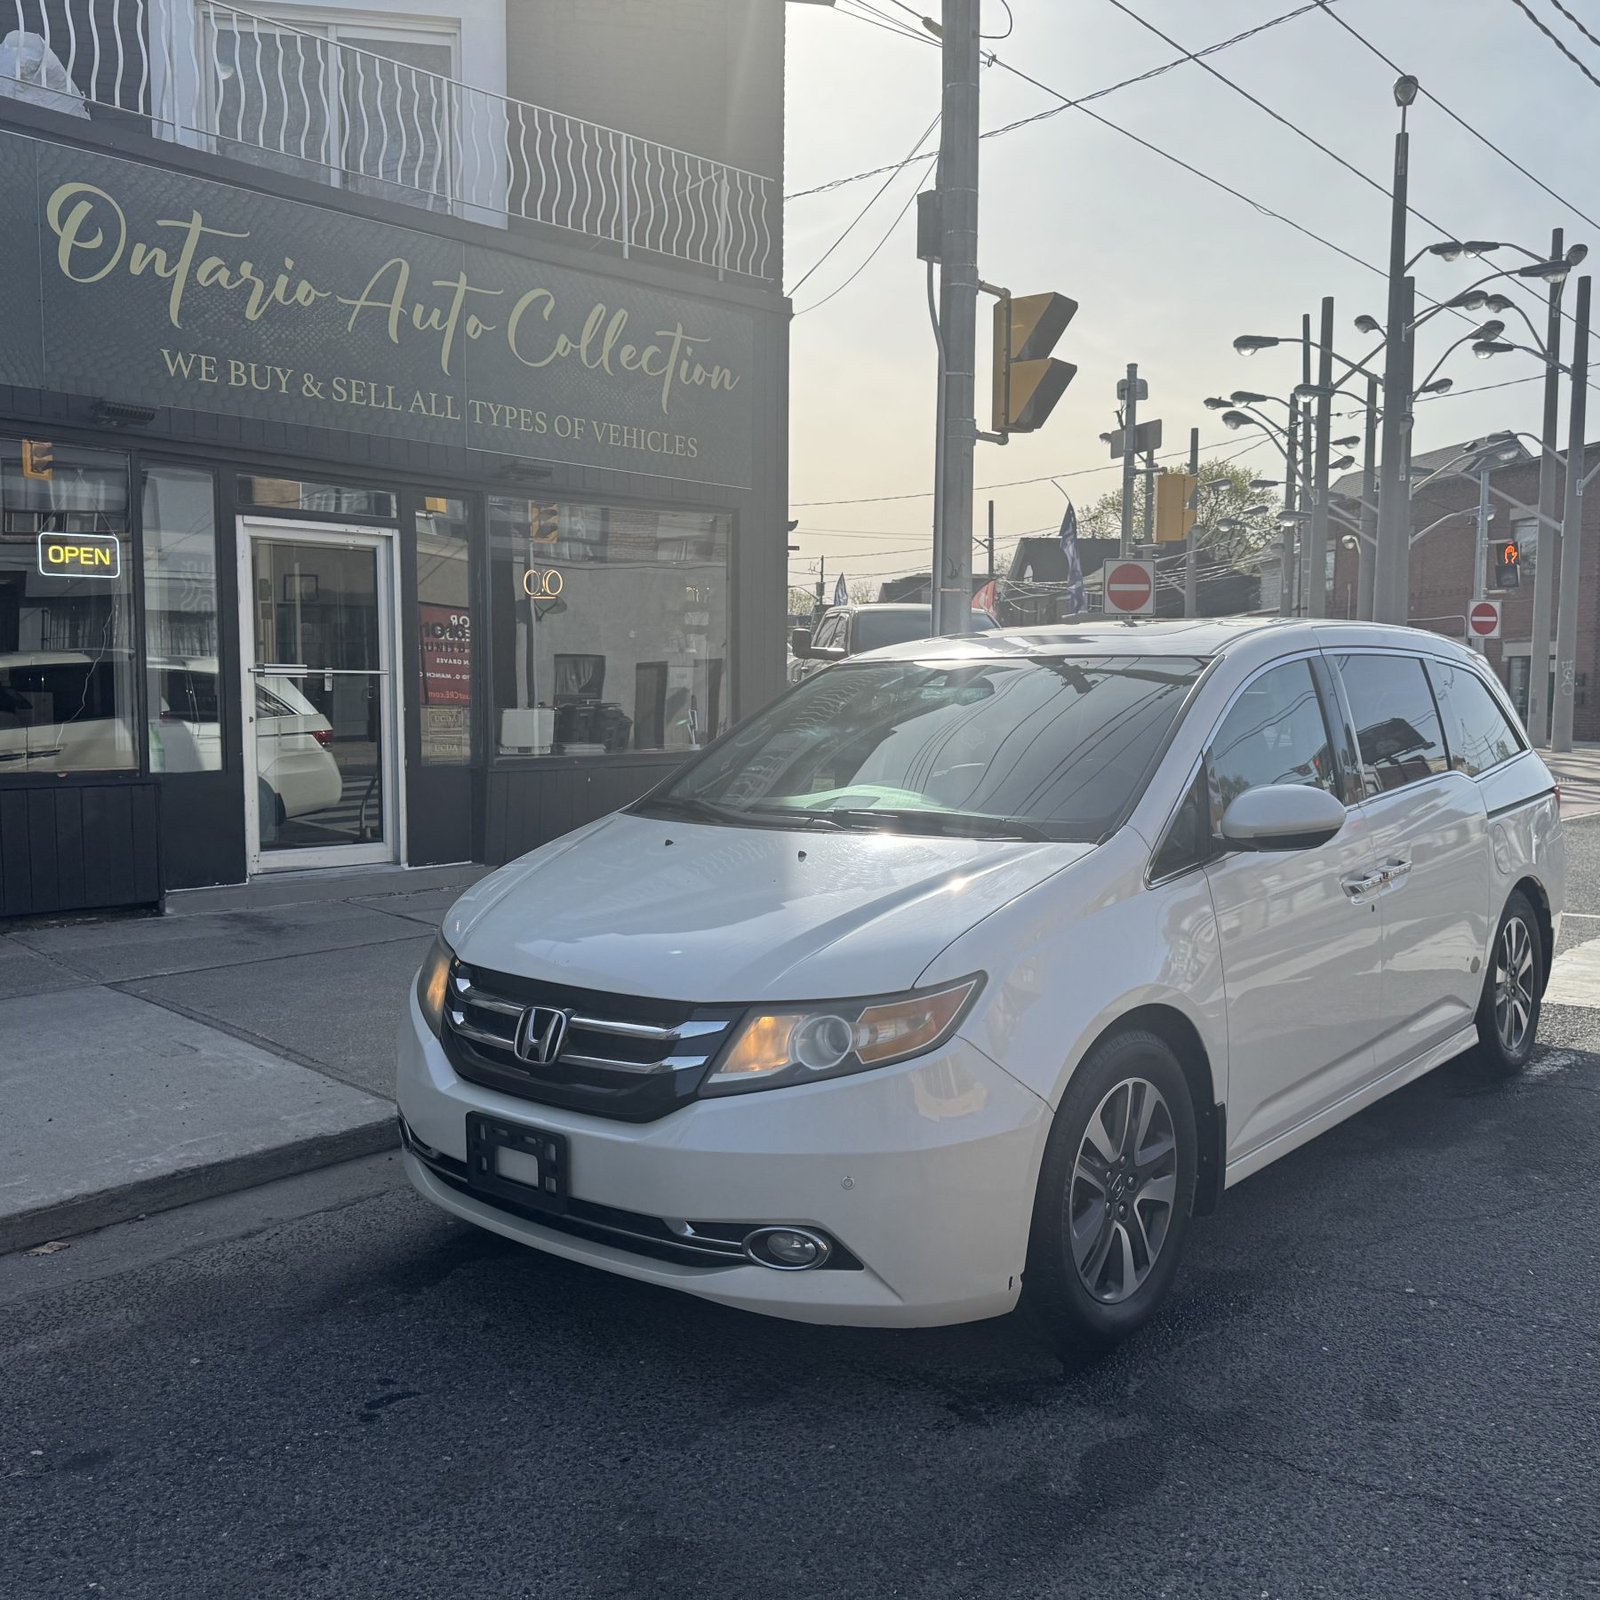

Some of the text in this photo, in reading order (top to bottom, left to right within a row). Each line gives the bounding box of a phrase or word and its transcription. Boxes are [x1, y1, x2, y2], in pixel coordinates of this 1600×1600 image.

[47, 182, 740, 414] Ontario Auto Collection
[160, 349, 698, 458] WE BUY & SELL ALL TYPES OF VEHICLES
[48, 545, 111, 566] OPEN
